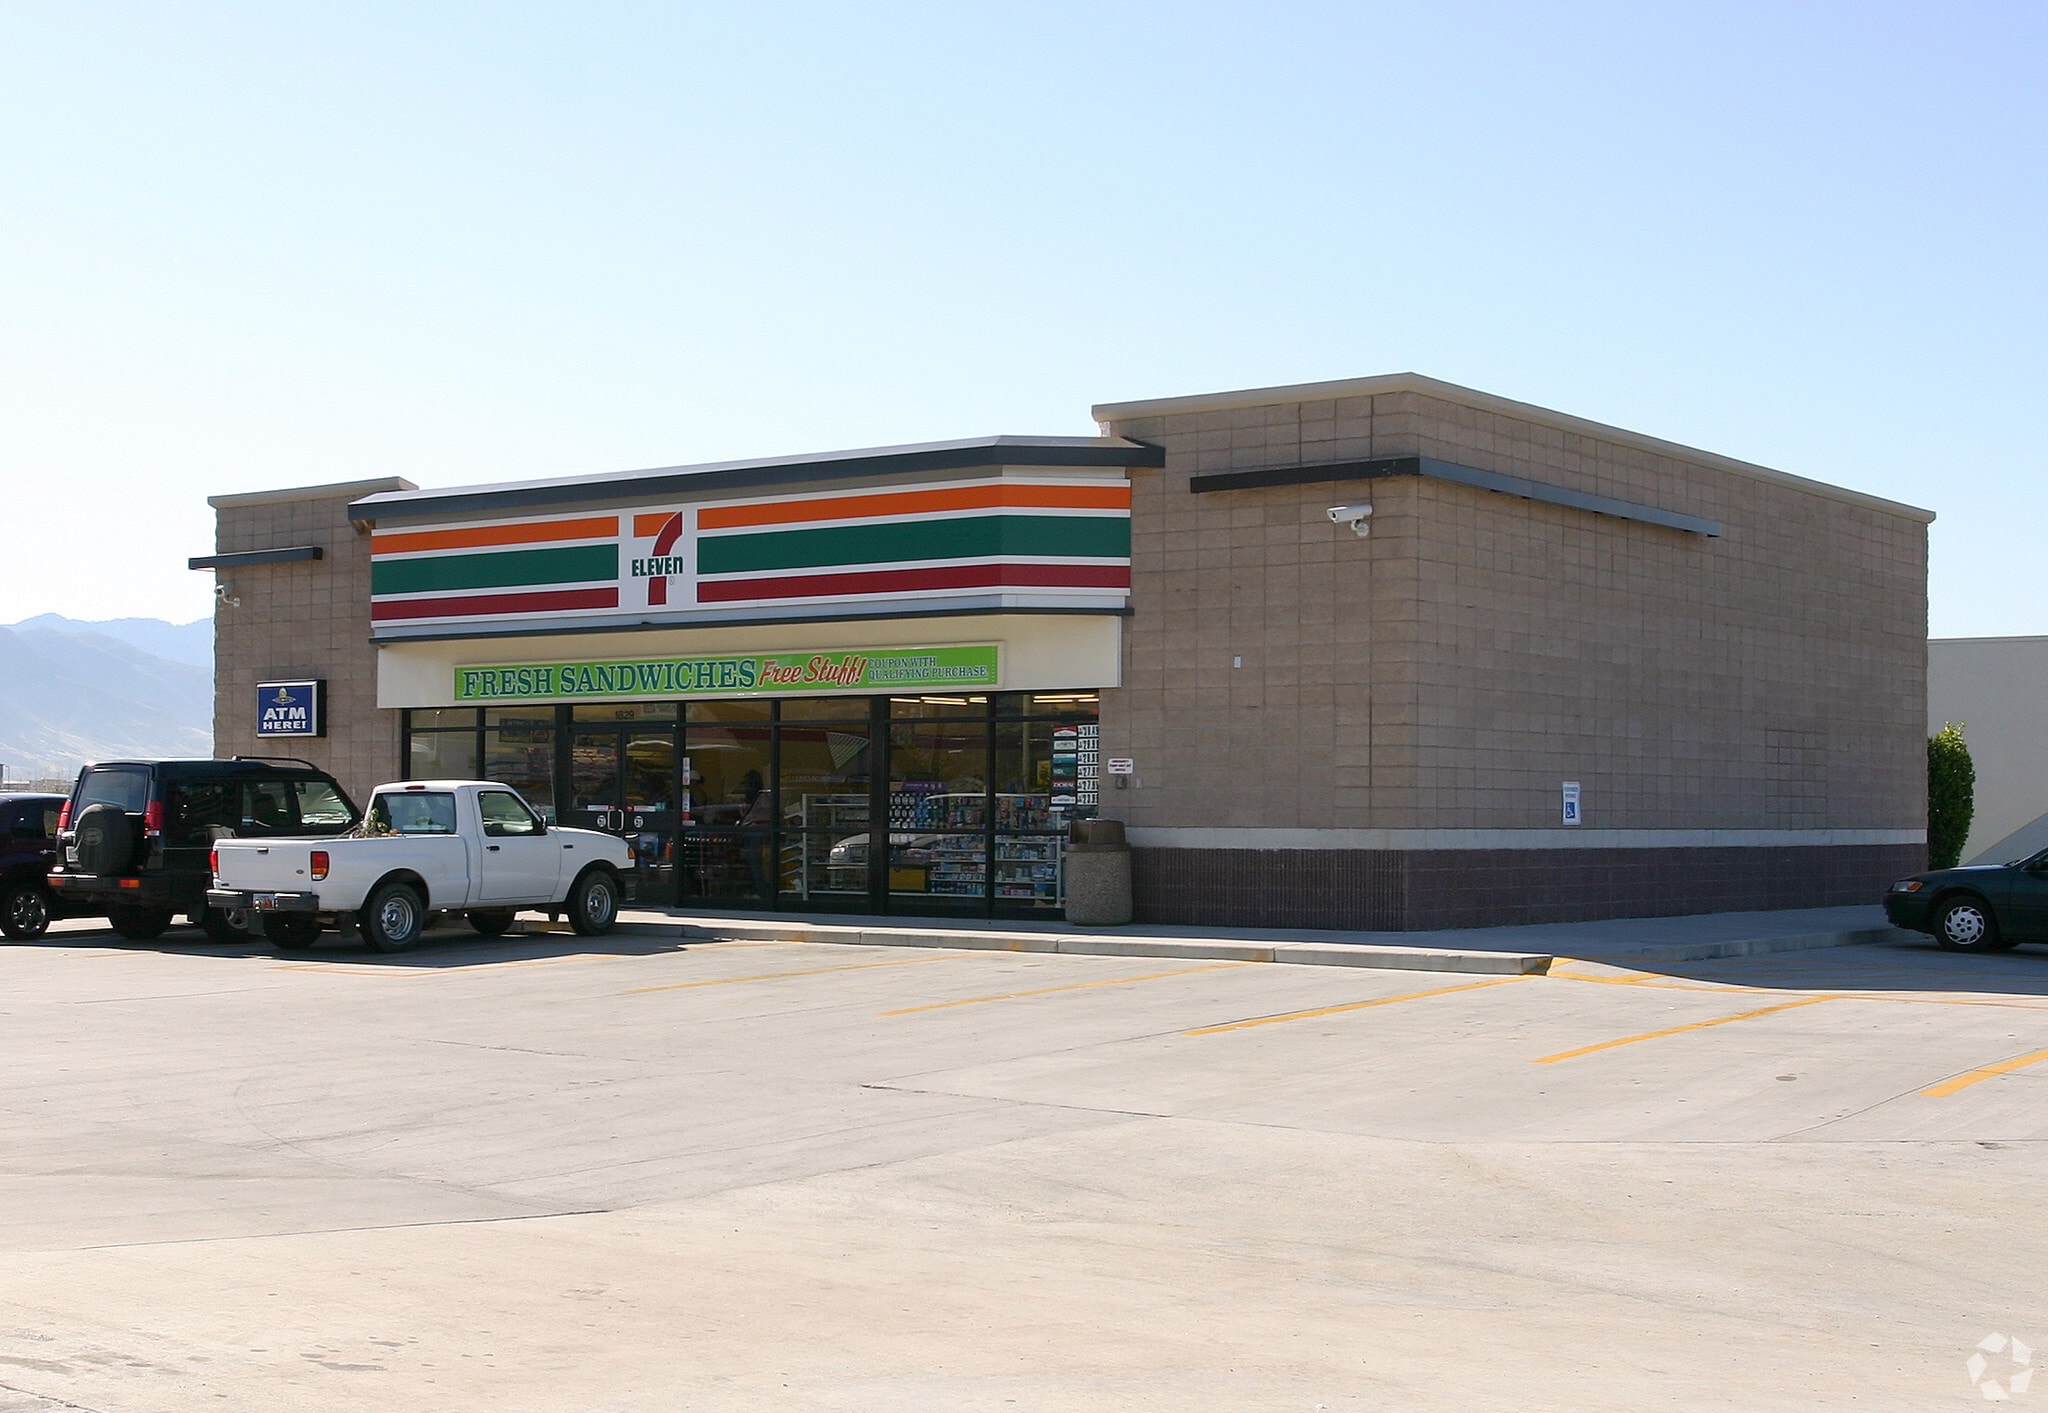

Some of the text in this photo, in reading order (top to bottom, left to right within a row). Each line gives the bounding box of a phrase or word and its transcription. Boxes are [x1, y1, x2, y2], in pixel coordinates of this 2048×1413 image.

[647, 511, 683, 606] 7
[868, 657, 936, 669] COUPON WITH
[462, 656, 868, 697] FRESH SANDWICHES Free Stuff!
[868, 666, 988, 680] QUALIFYING PURCHASE
[263, 706, 306, 720] ATM
[615, 710, 635, 720] 1829
[262, 720, 307, 730] HERE!
